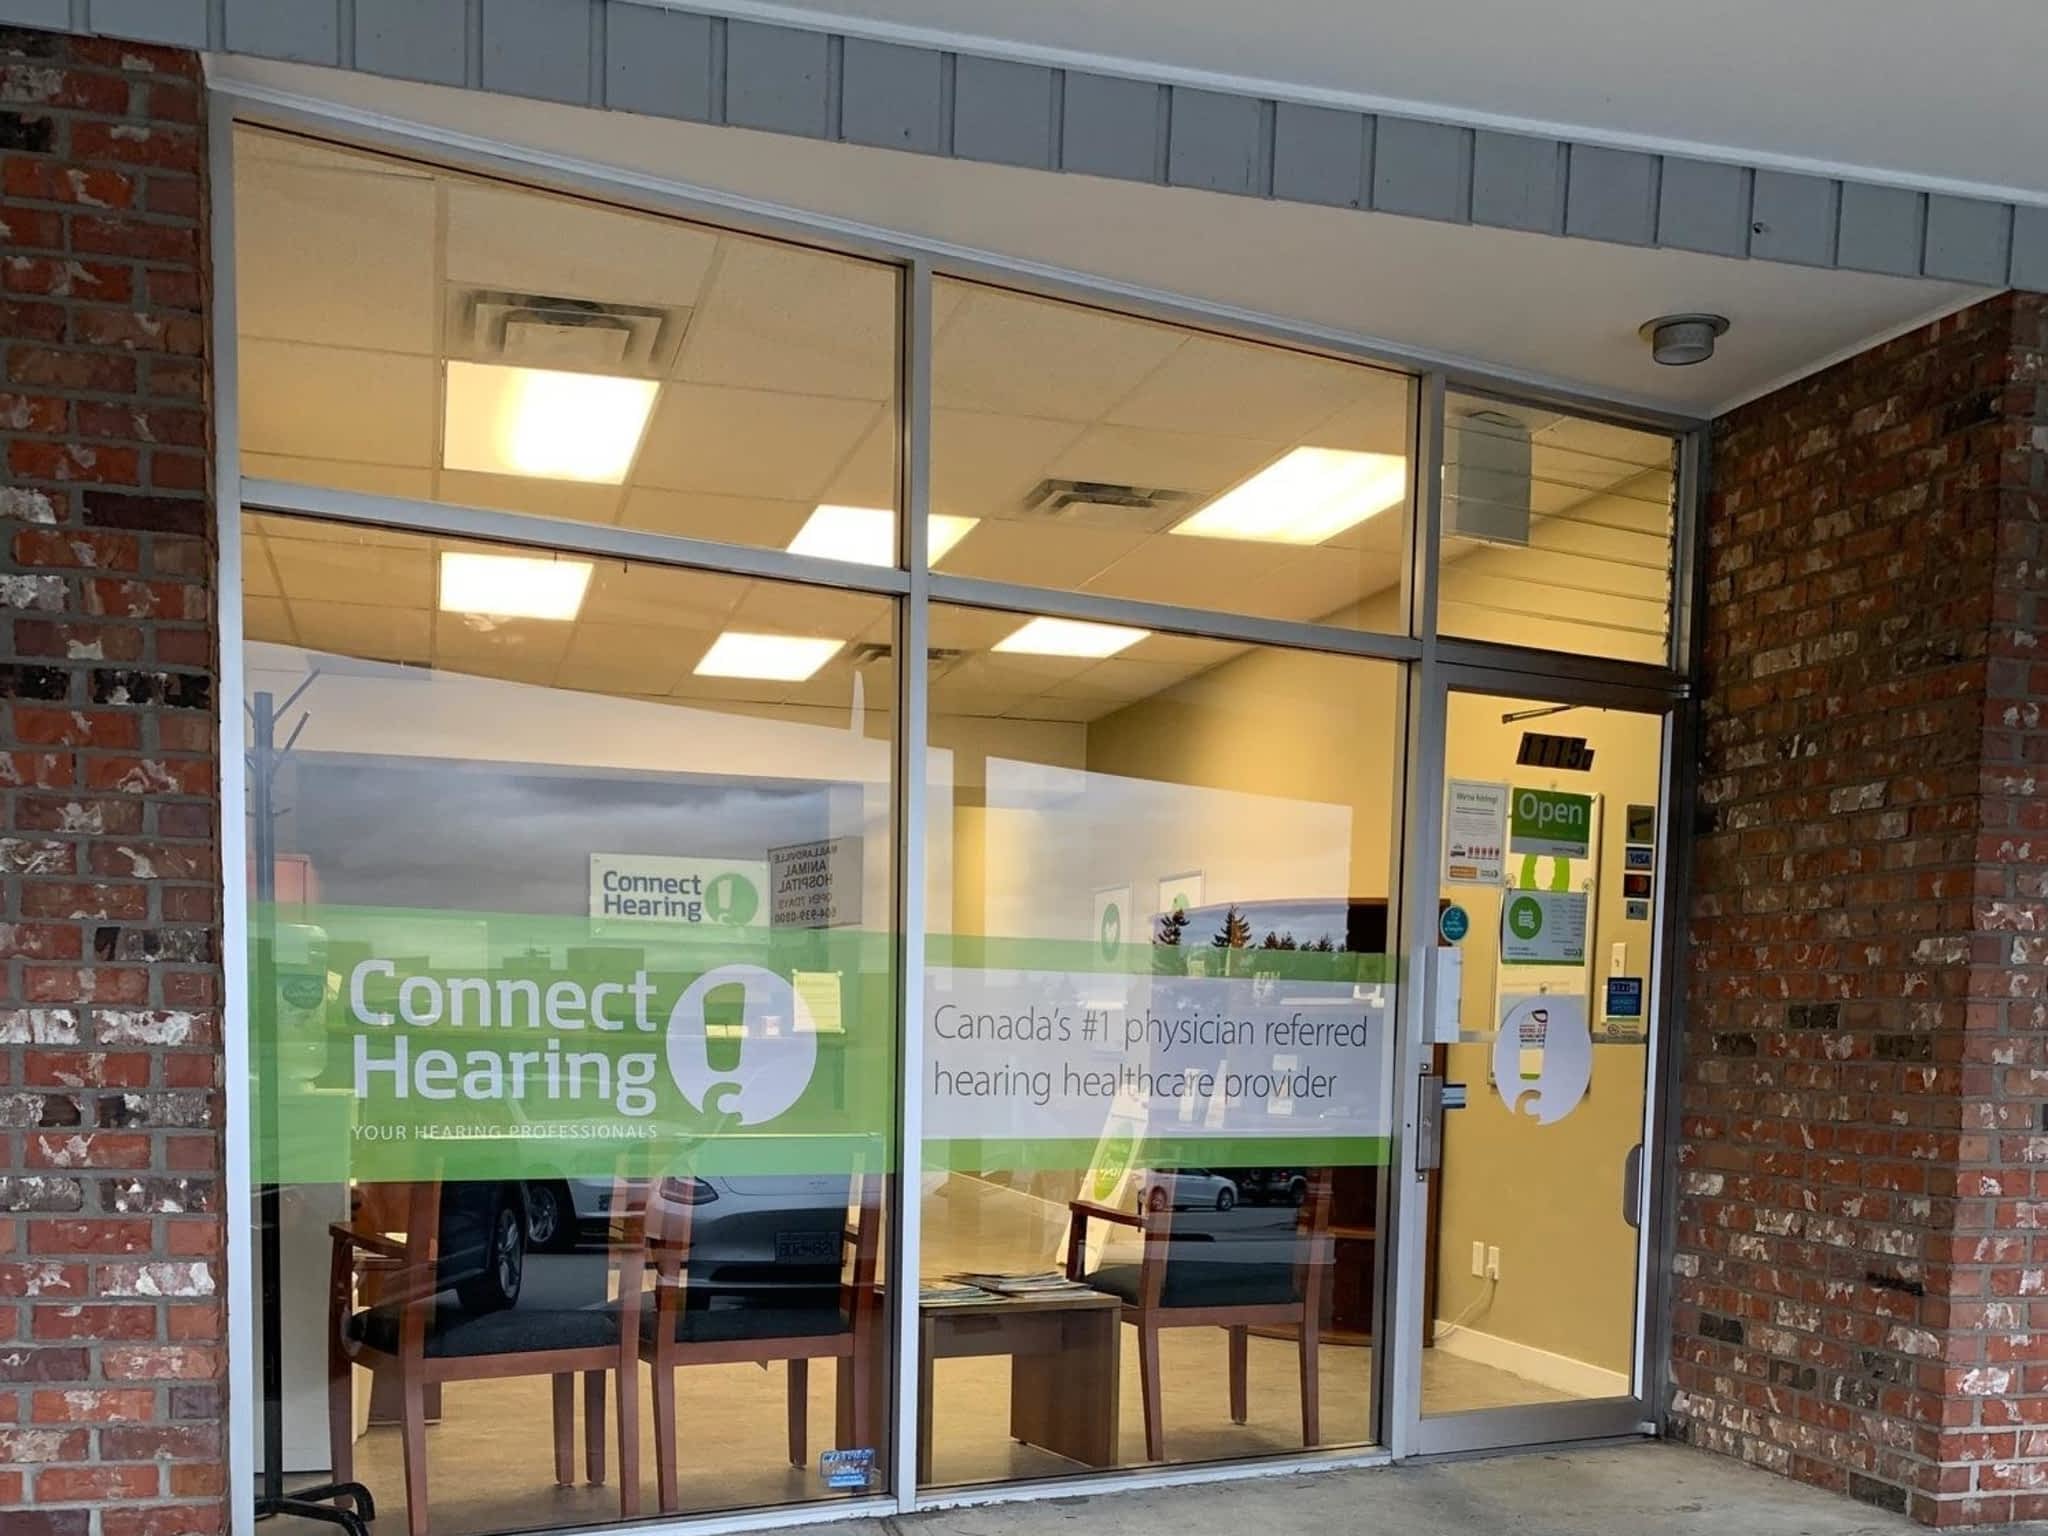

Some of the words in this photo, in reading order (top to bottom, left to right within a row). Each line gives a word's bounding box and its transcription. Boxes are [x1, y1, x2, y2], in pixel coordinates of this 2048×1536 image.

[1519, 792, 1583, 829] Open
[1629, 852, 1650, 864] VISA
[603, 870, 702, 895] Connect
[603, 893, 702, 922] Hearing
[350, 959, 657, 1031] Connect
[934, 1004, 1071, 1042] Canada's
[1081, 1009, 1109, 1041] #1
[1124, 1009, 1254, 1052] physician
[1265, 1013, 1368, 1048] referred
[353, 1034, 657, 1116] Hearing
[934, 1060, 1050, 1106] hearing
[1063, 1061, 1214, 1099] healthcare
[1224, 1065, 1337, 1105] provider
[353, 1124, 406, 1140] YOUR
[415, 1125, 501, 1140] HEARING
[511, 1124, 657, 1140] PROFESSIONALS
